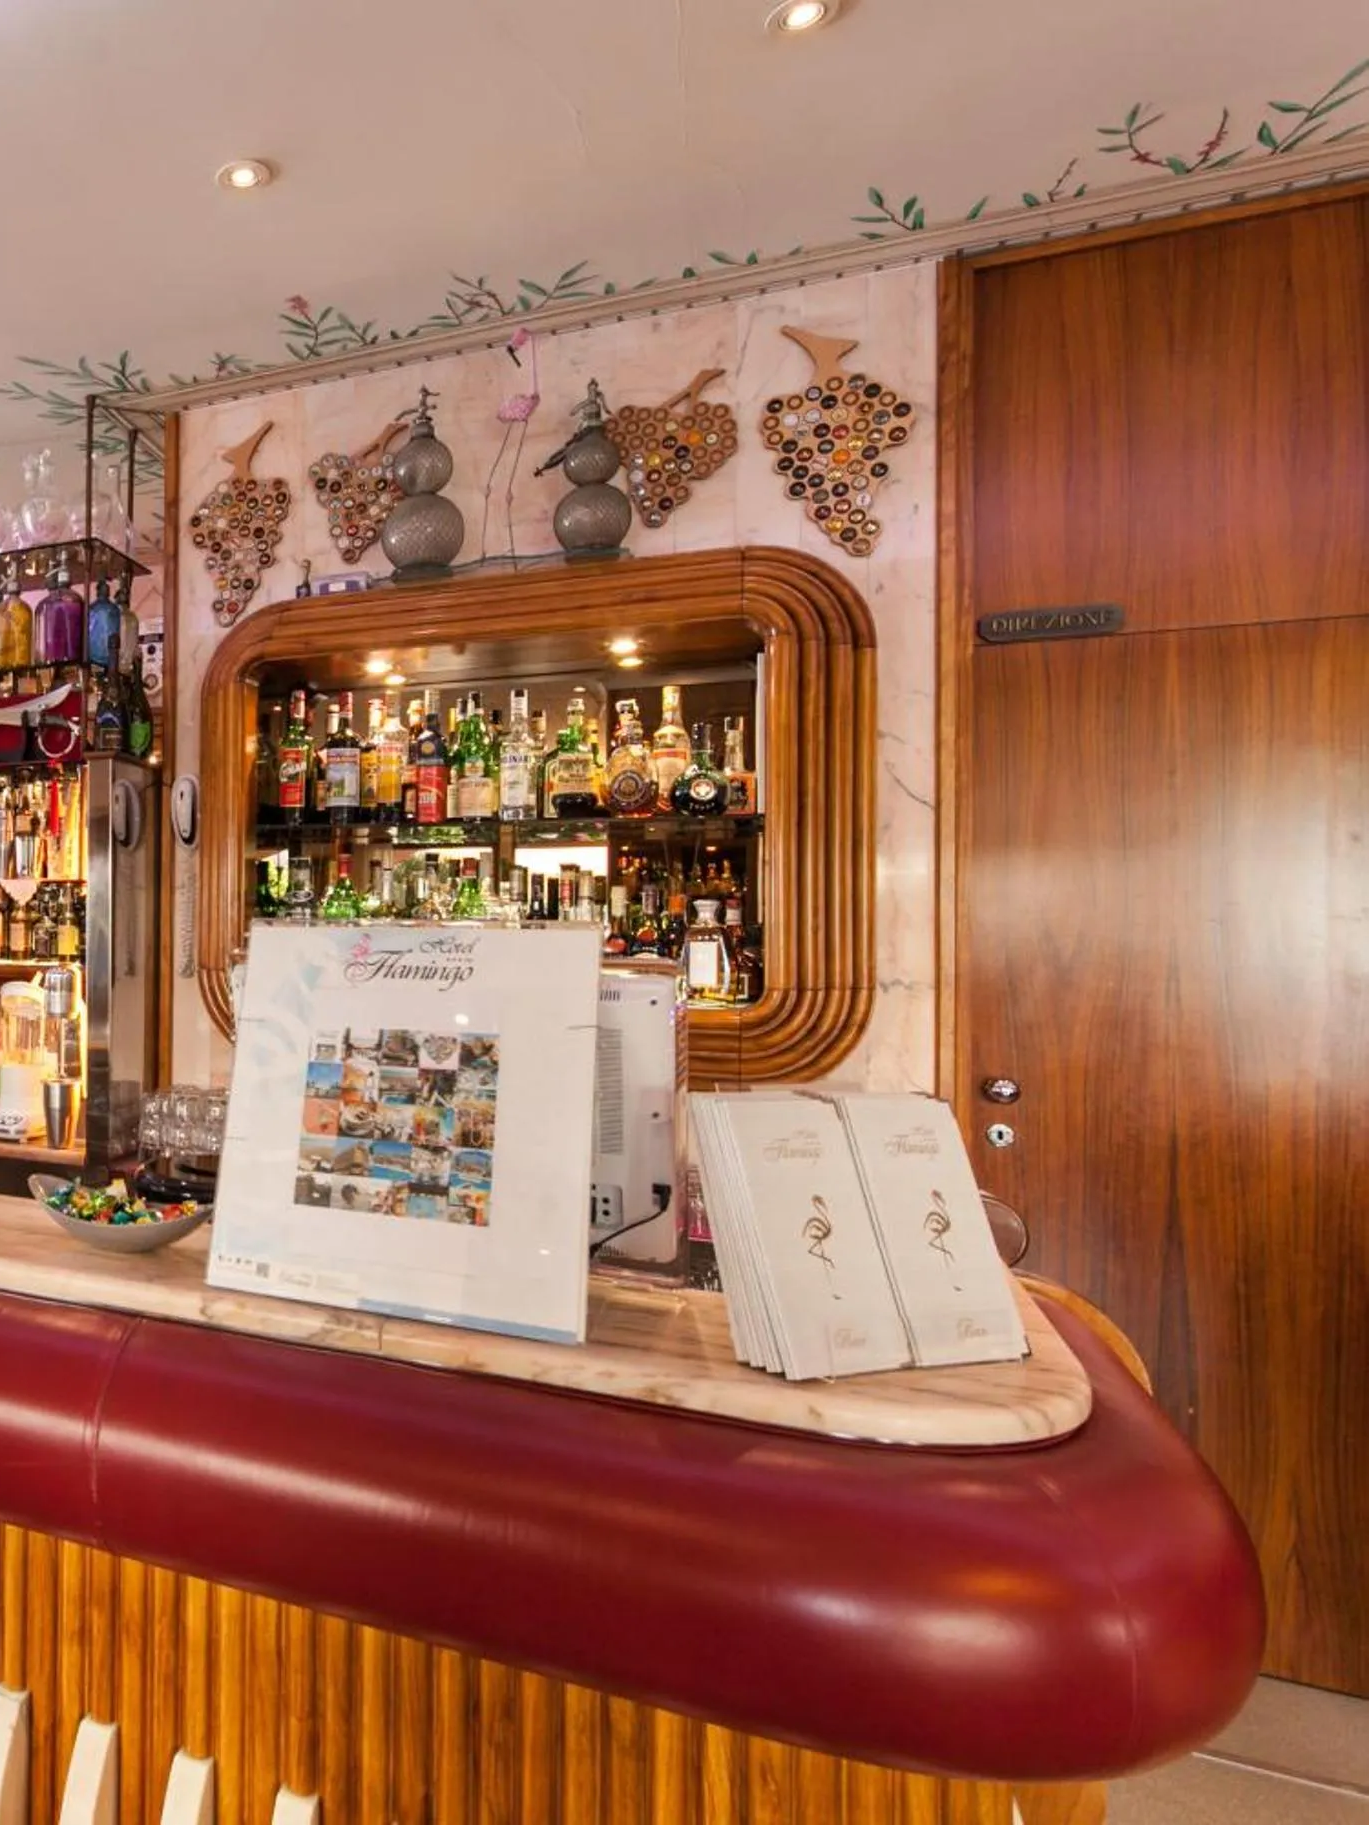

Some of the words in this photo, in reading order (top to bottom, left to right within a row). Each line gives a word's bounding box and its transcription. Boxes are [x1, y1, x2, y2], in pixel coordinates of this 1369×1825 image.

[991, 609, 1111, 633] DIREZIONE
[419, 935, 480, 955] Hotel
[344, 949, 474, 991] Flamingo
